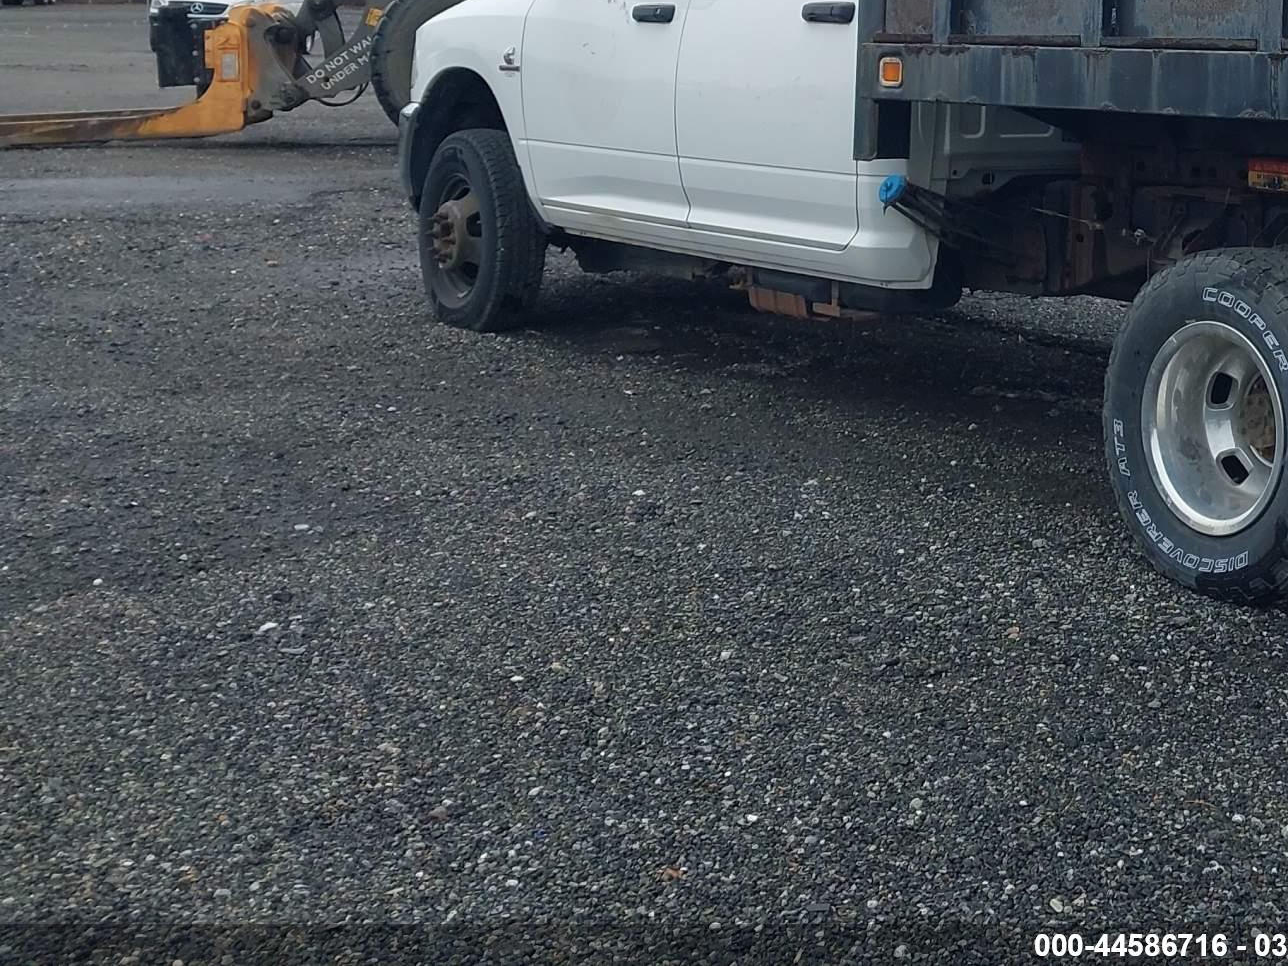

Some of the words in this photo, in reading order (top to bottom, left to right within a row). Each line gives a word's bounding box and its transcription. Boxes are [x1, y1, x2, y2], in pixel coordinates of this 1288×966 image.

[306, 69, 325, 84] DO
[324, 51, 350, 72] NOT
[320, 62, 360, 90] UNDER
[1112, 418, 1132, 477] AT3
[1126, 489, 1249, 574] DISCOVERER
